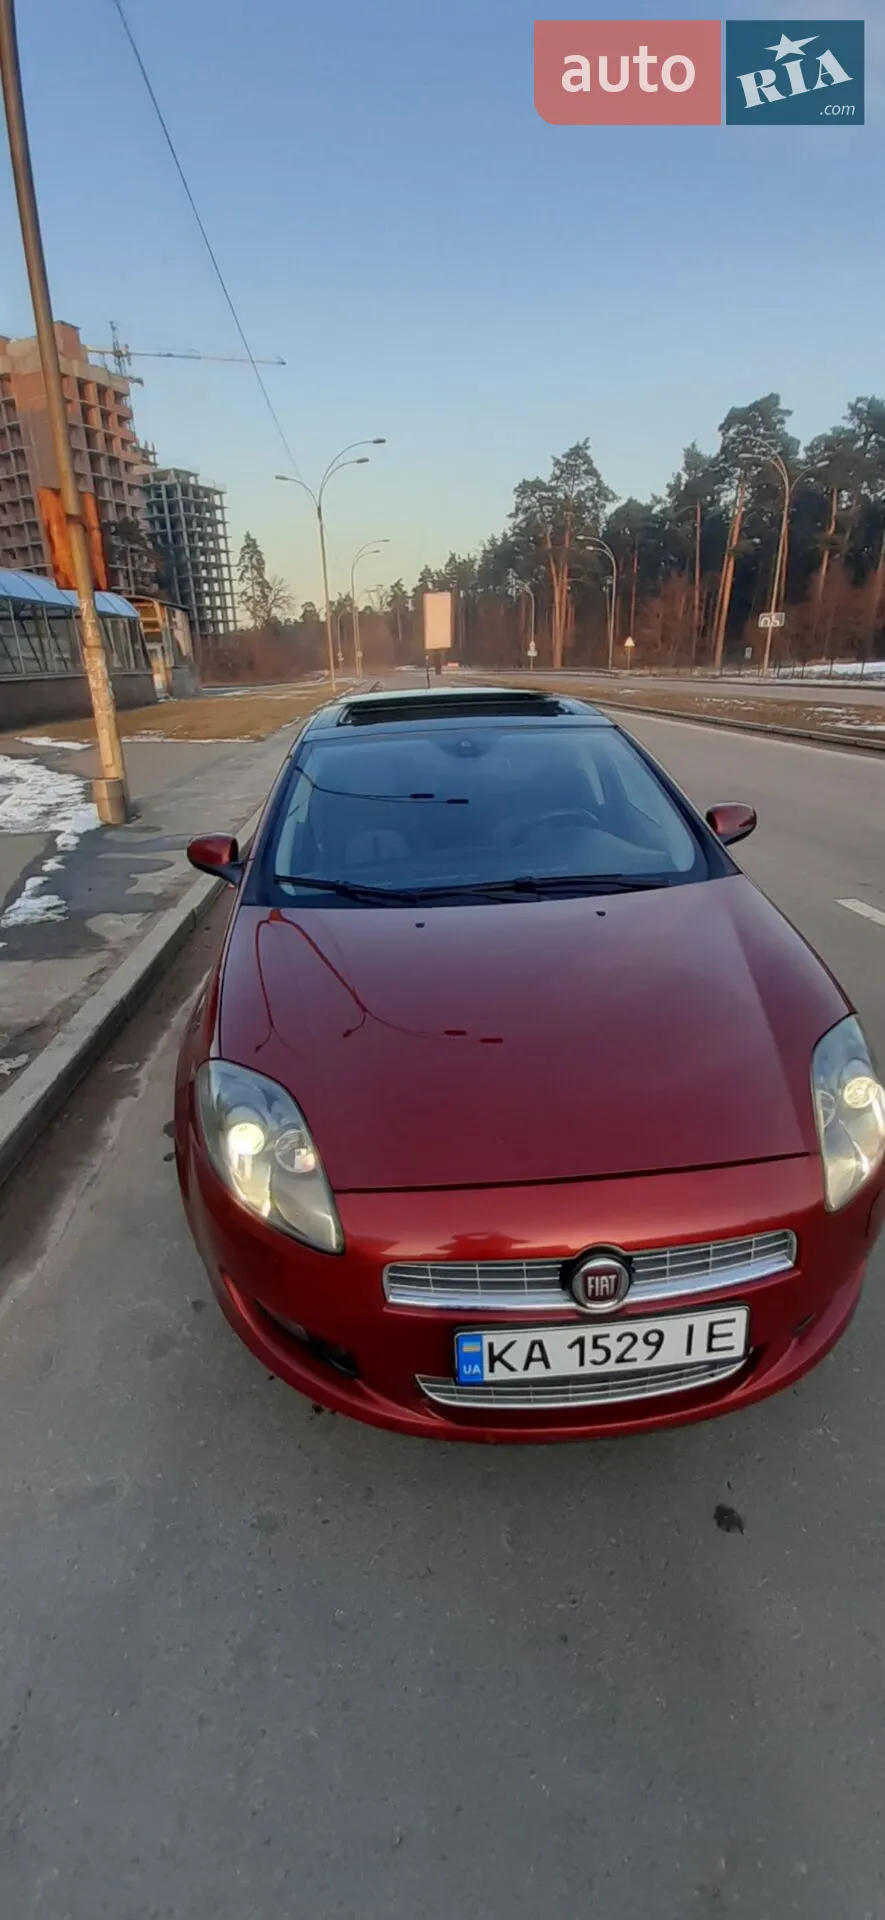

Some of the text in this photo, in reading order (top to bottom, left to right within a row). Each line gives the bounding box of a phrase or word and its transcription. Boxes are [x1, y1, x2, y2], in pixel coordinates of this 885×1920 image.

[587, 1274, 617, 1297] FIAT
[487, 1317, 737, 1373] KA 1529 IE
[463, 1364, 481, 1375] UA
